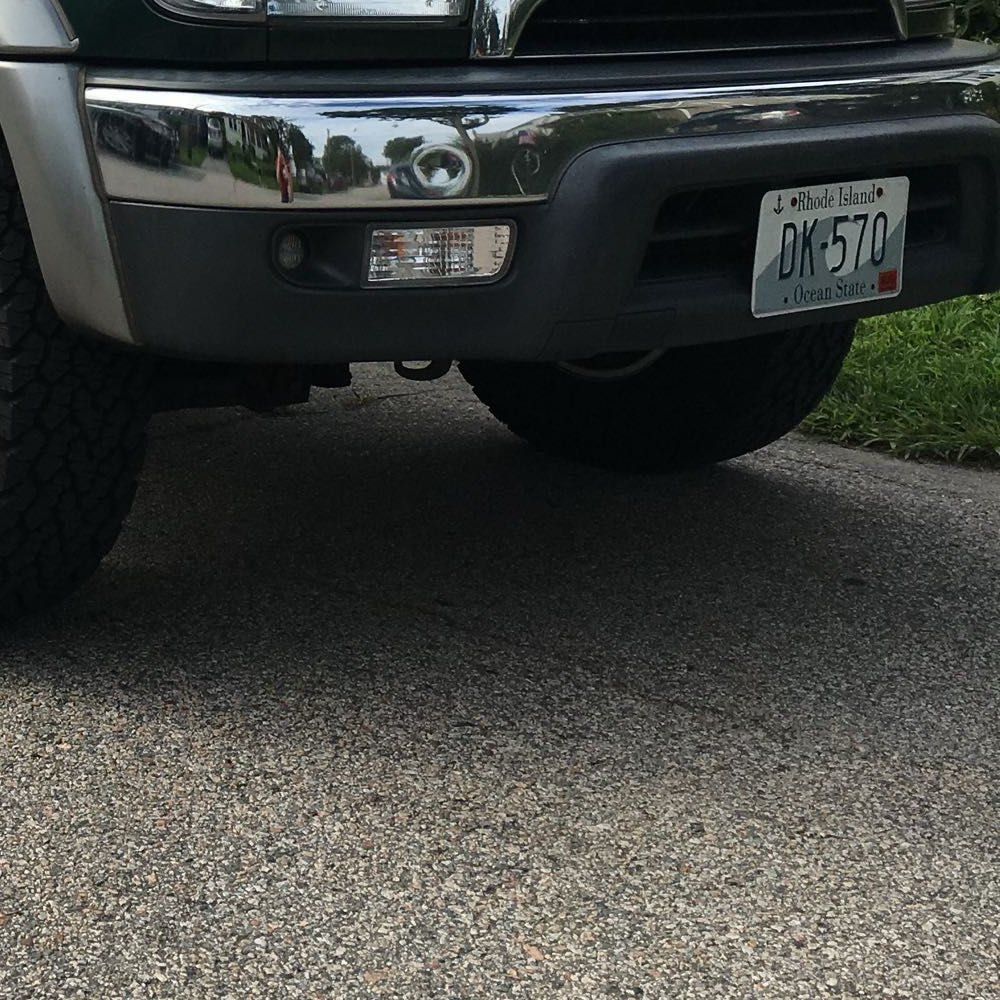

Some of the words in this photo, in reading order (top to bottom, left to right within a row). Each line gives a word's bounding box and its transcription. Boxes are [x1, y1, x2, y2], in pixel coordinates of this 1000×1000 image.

[797, 189, 835, 212] Rhode
[838, 184, 876, 208] Island
[778, 211, 888, 281] DK-570
[793, 284, 833, 305] Ocean
[836, 278, 867, 299] State
